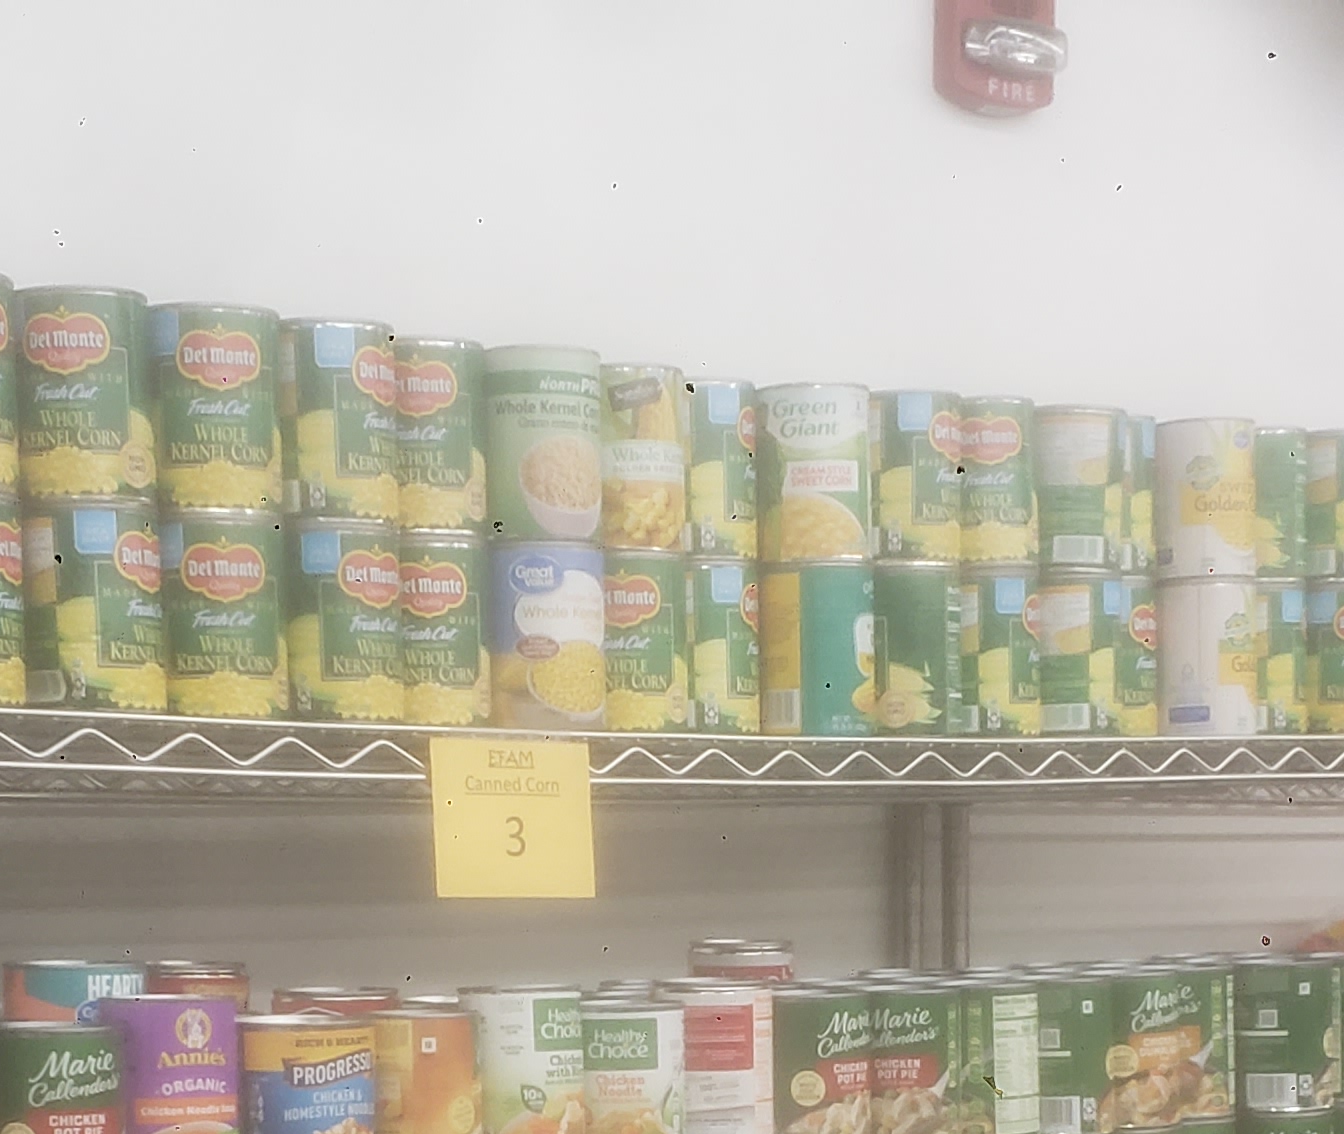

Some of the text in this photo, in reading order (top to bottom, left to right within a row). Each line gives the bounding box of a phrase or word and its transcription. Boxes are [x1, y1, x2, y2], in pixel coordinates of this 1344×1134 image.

[988, 77, 1036, 102] FIRE
[772, 399, 837, 419] Green
[780, 417, 839, 438] Giant
[213, 561, 259, 577] Monte
[515, 565, 554, 581] Great
[418, 577, 462, 594] Monte
[524, 574, 553, 587] Value
[465, 775, 560, 793] Canned Corn
[505, 816, 526, 857] 3
[594, 1029, 647, 1046] Healthy
[158, 1049, 226, 1068] Annie's
[588, 1042, 648, 1059] Choice
[28, 1050, 115, 1083] Marie
[161, 1078, 227, 1095] ORGANIC
[596, 1075, 645, 1086] Chicken
[599, 1084, 643, 1098] Noodle
[49, 1114, 106, 1127] CHICKEN
[284, 1105, 345, 1121] HOMESTYLE
